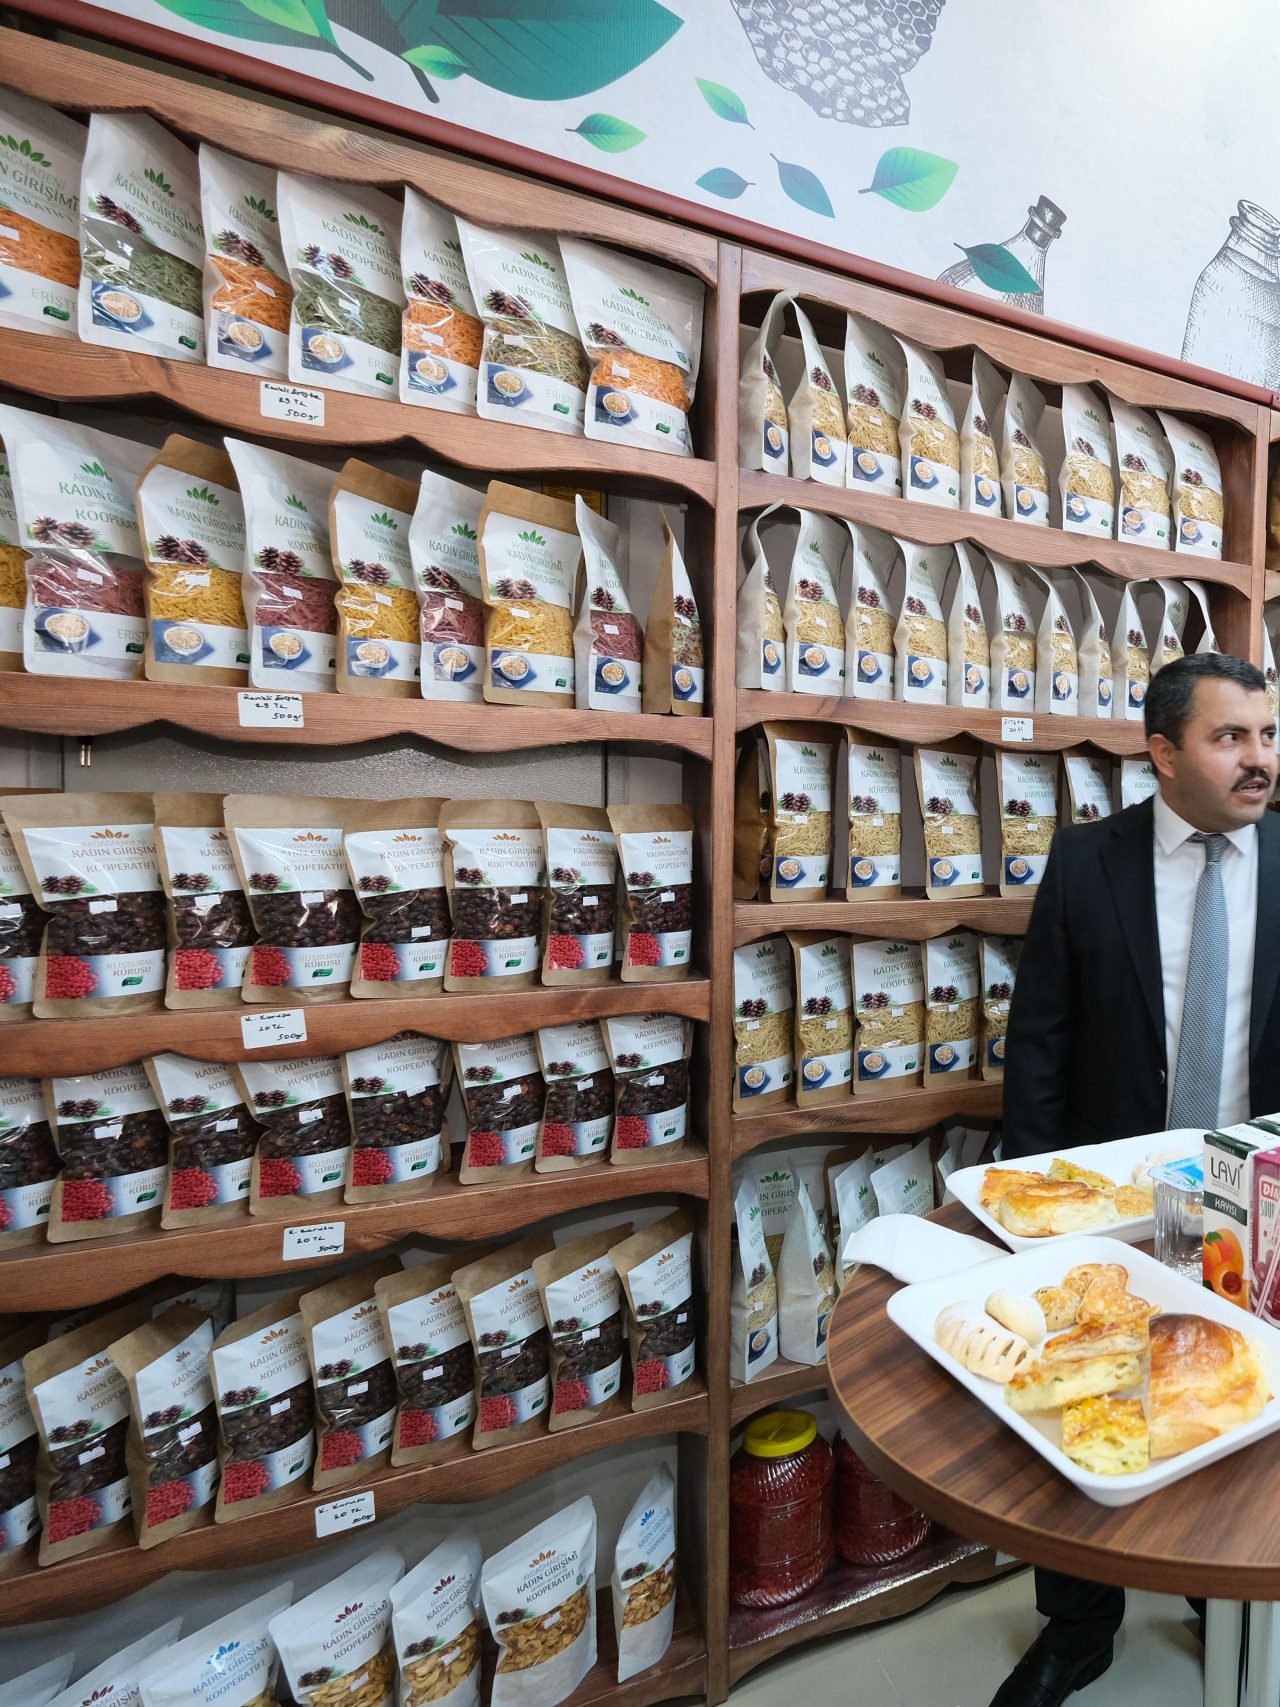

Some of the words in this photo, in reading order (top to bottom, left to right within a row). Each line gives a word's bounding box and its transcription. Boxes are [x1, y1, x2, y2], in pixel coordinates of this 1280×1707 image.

[321, 219, 363, 249] KADIN
[502, 262, 539, 282] KADIN
[602, 297, 635, 318] KADIN
[58, 482, 105, 502] KADIN
[167, 506, 202, 526] KADIN
[429, 539, 458, 556] KADIN
[72, 848, 111, 858] KADIN
[200, 848, 229, 857] KADIN
[872, 964, 900, 976] KADIN
[634, 1028, 657, 1039] KADIN
[377, 1049, 406, 1061] KADIN
[91, 1068, 129, 1082] KADIN
[194, 1064, 227, 1079] KADIN
[273, 1061, 309, 1075] KADIN
[1214, 1197, 1238, 1218] KAYISI
[499, 1301, 522, 1317] KADIN
[419, 1311, 446, 1328] KADIN
[344, 1328, 369, 1344] KADIN
[249, 1350, 278, 1370] KADIN
[76, 1382, 108, 1402] KADIN
[516, 1573, 544, 1594] KADIN
[425, 1602, 450, 1622] KADIN
[322, 1628, 353, 1652] KADIN
[192, 1669, 227, 1695] KADIN
